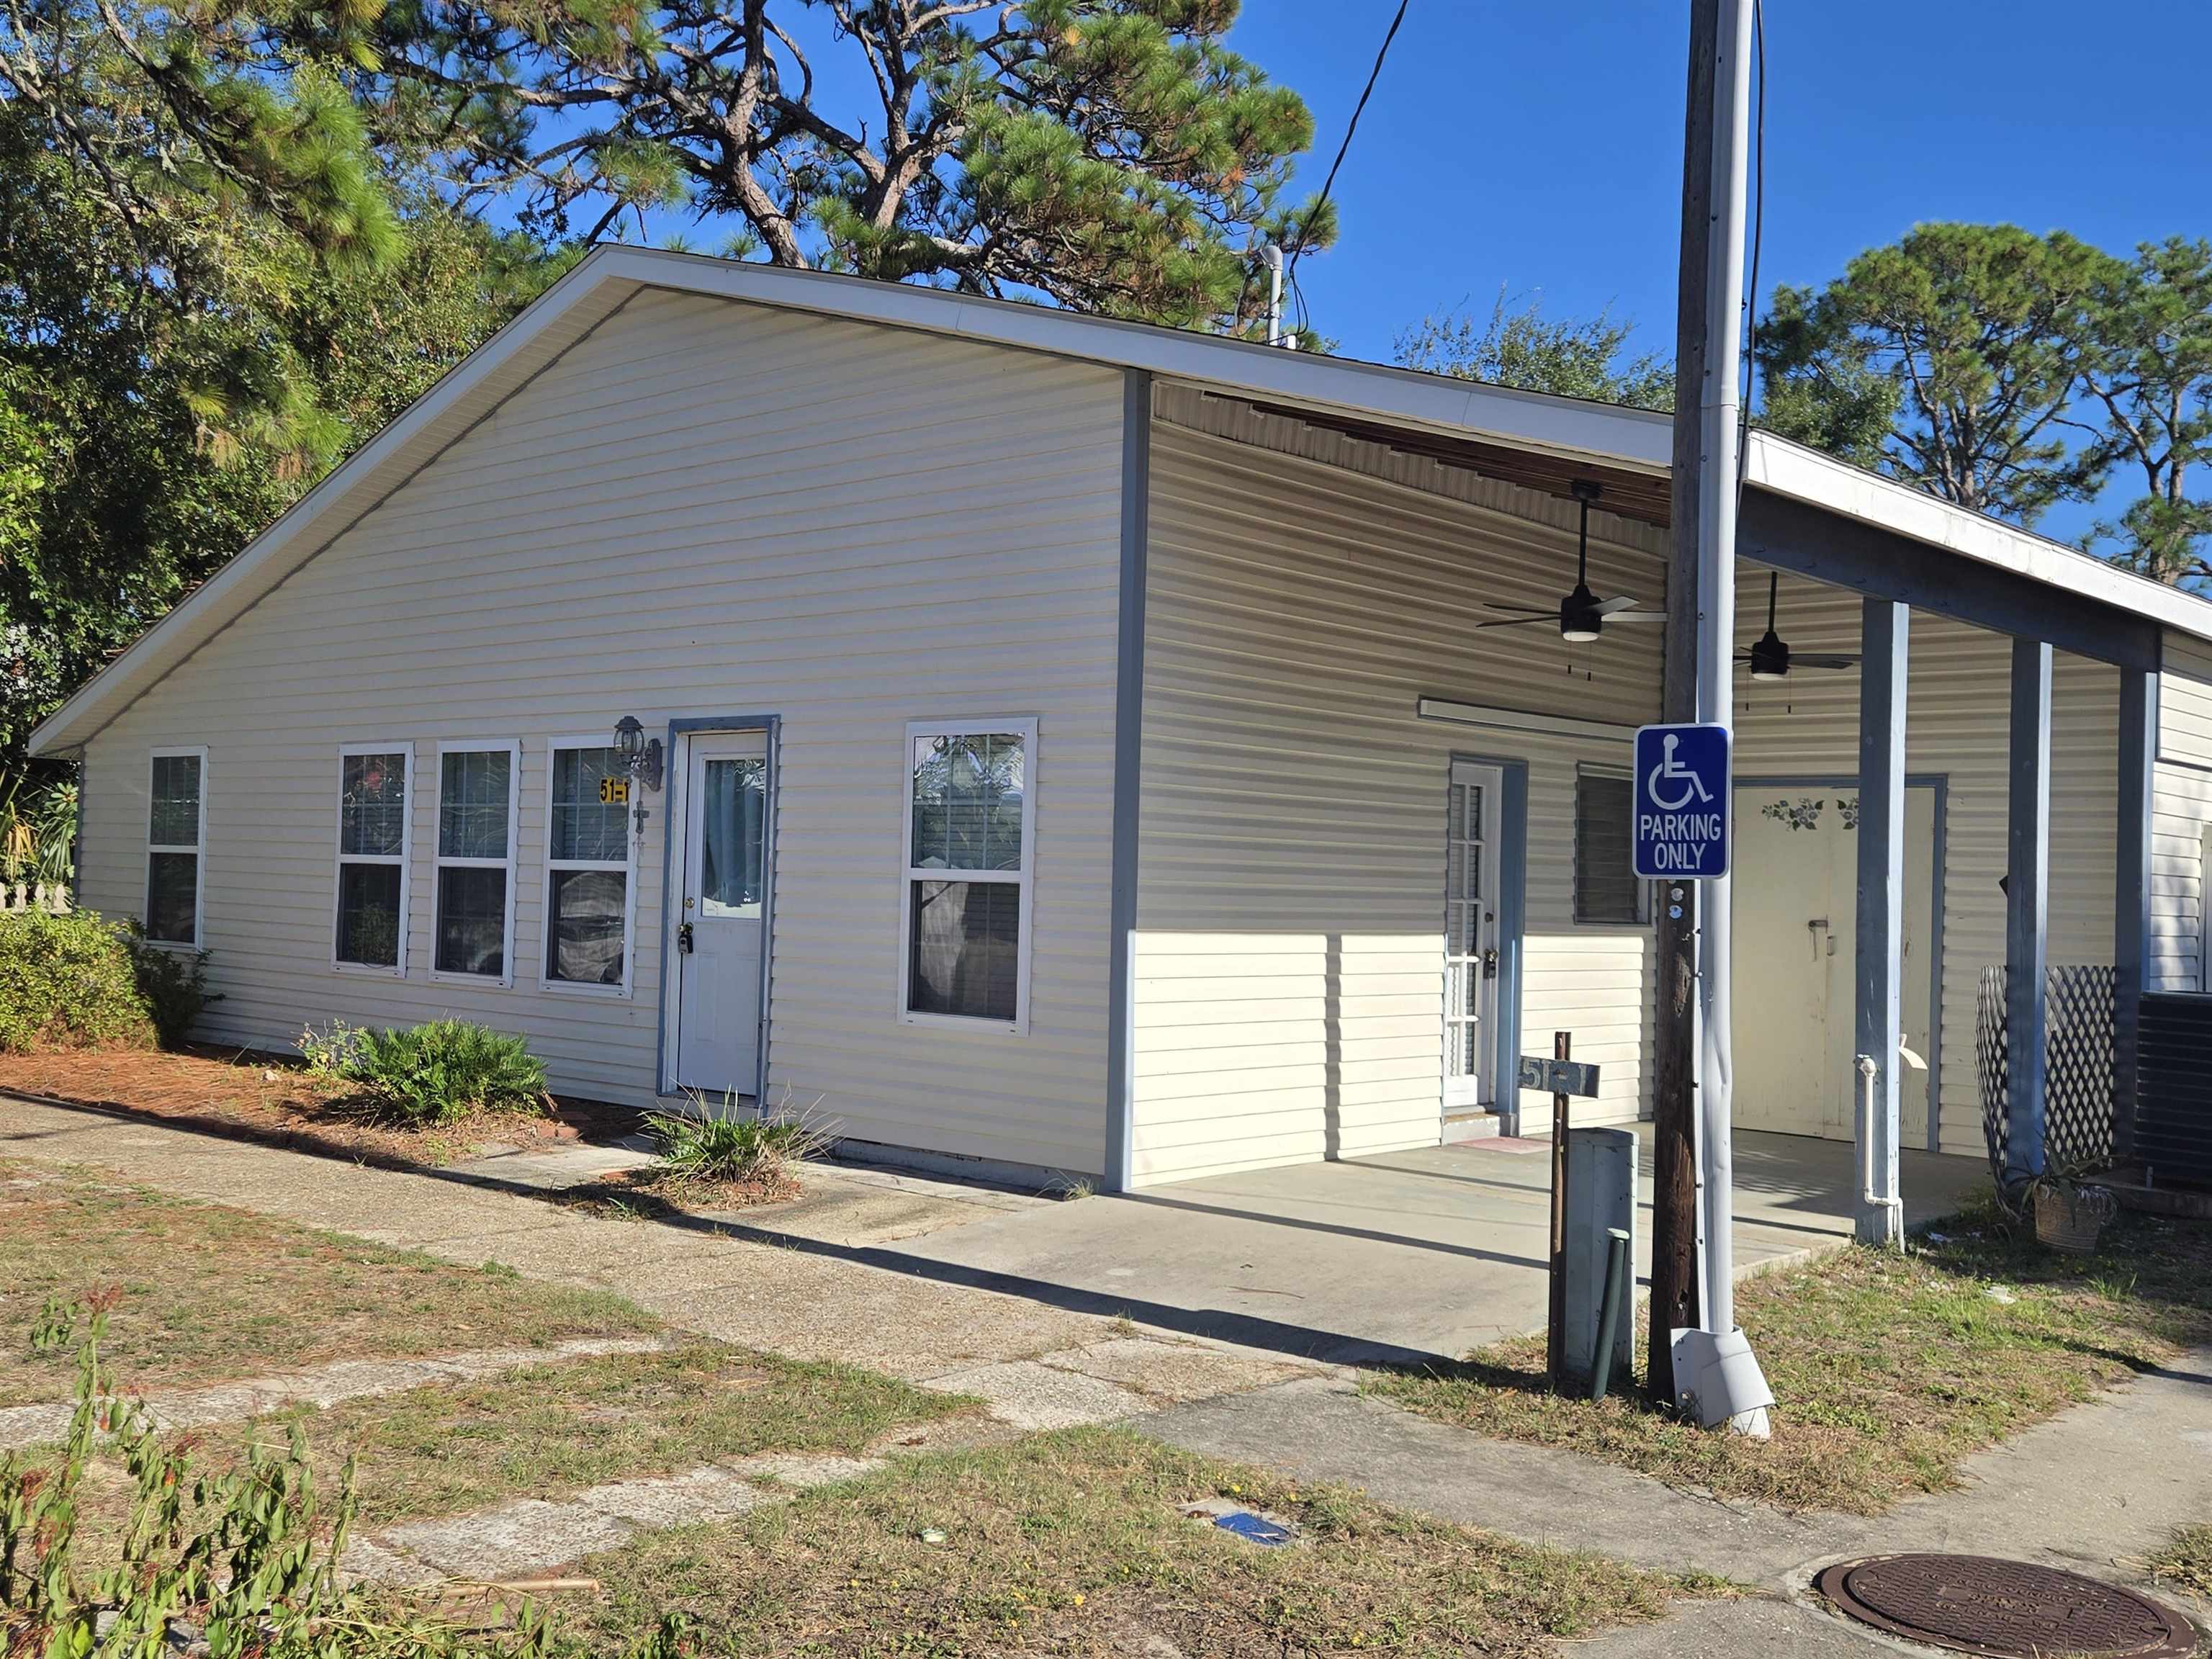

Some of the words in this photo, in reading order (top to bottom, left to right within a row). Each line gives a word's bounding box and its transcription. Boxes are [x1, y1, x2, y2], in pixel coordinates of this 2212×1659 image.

[600, 778, 629, 802] 51-1
[1640, 814, 1722, 841] PARKING
[1654, 842, 1707, 870] ONLY
